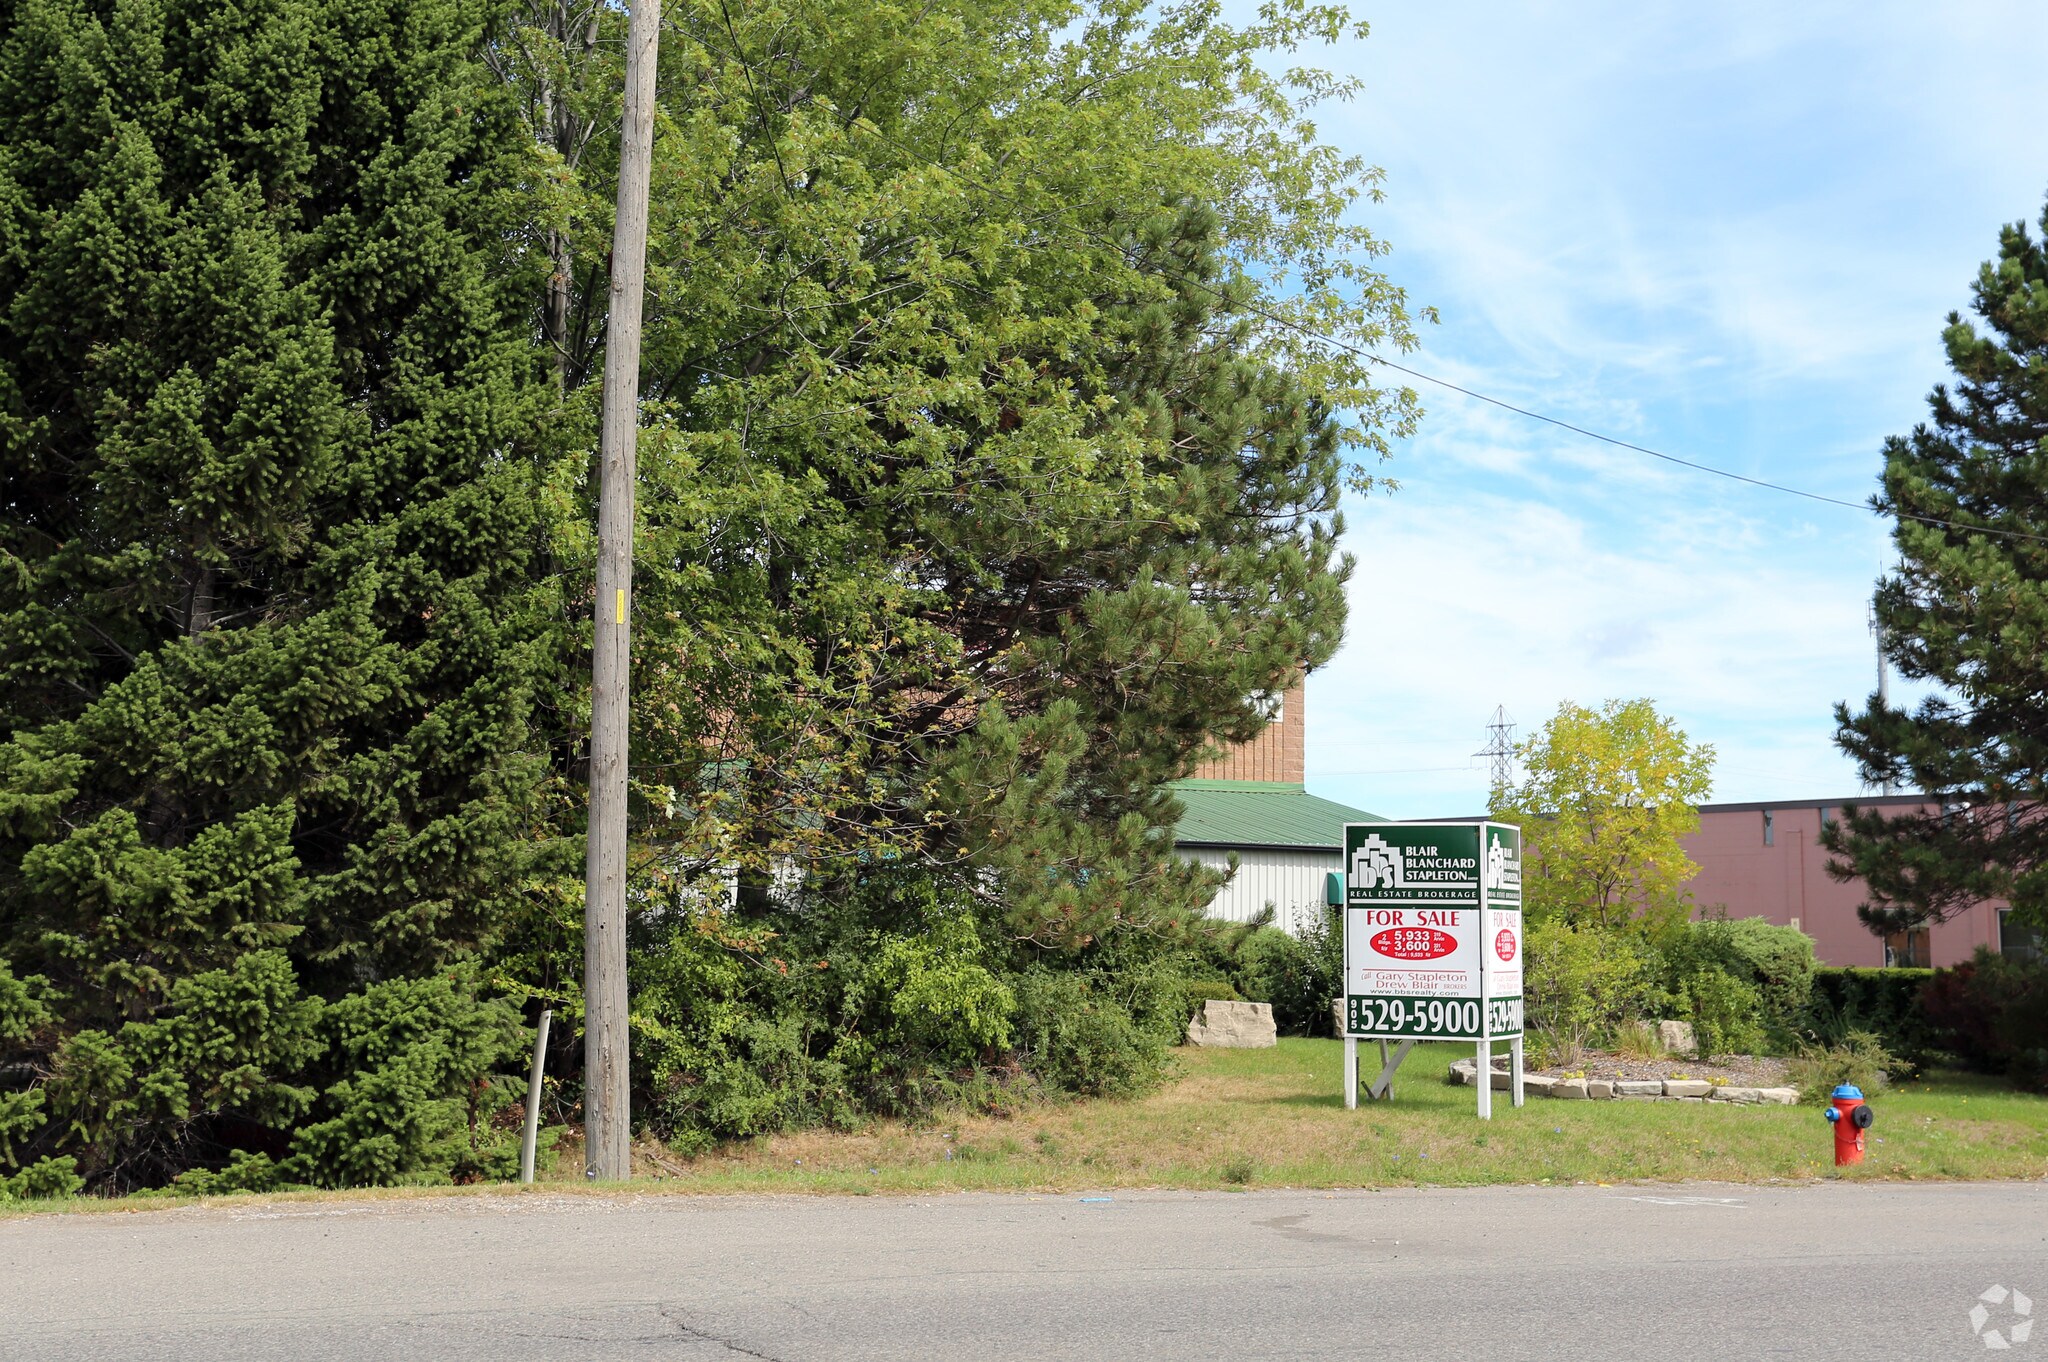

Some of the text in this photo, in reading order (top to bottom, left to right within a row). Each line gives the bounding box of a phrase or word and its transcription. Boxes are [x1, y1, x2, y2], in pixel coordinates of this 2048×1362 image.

[1405, 846, 1438, 857] BLAIR
[1405, 858, 1476, 869] BLANCHARD
[1405, 870, 1468, 881] STAPLETON
[1350, 890, 1476, 899] REAL ESTATE BROKERAGE
[1366, 910, 1460, 927] FOR SALE
[1394, 930, 1430, 942] 5,933
[1394, 941, 1430, 952] 3,600
[1376, 972, 1468, 982] Gary Stapleton
[1376, 980, 1408, 989] Drew
[1412, 981, 1439, 989] Blair
[1369, 988, 1460, 997] www.bbsrealty.com
[1350, 999, 1358, 1029] 905
[1360, 999, 1480, 1034] 529-5900
